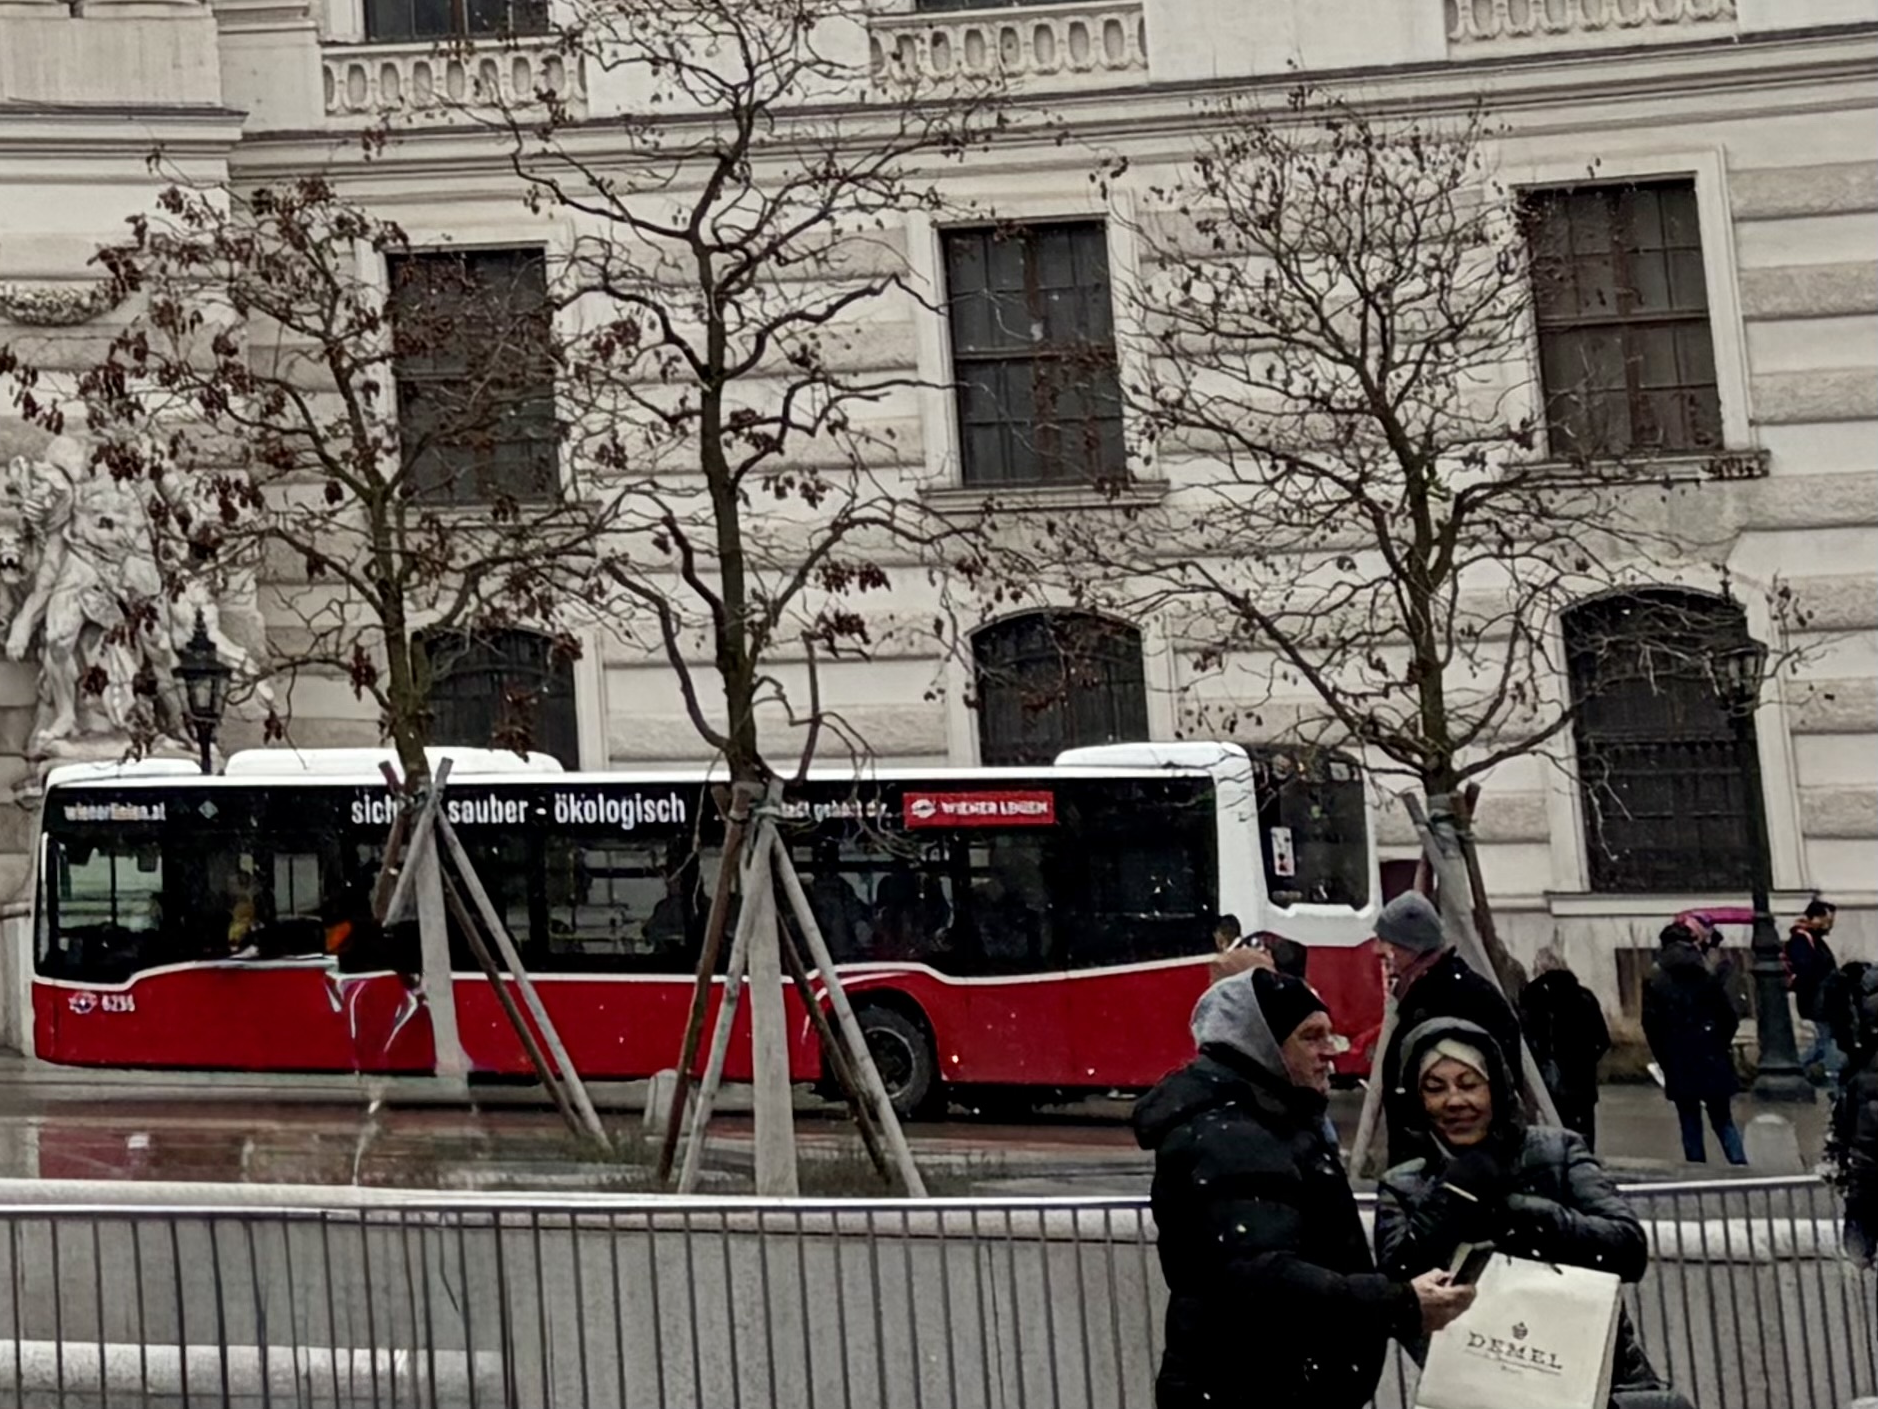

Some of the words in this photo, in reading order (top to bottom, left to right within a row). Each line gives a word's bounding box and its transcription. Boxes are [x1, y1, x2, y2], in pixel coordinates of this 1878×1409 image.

[448, 793, 529, 824] sauber
[553, 792, 686, 831] ökologisch
[1467, 1331, 1563, 1370] DEMEL
